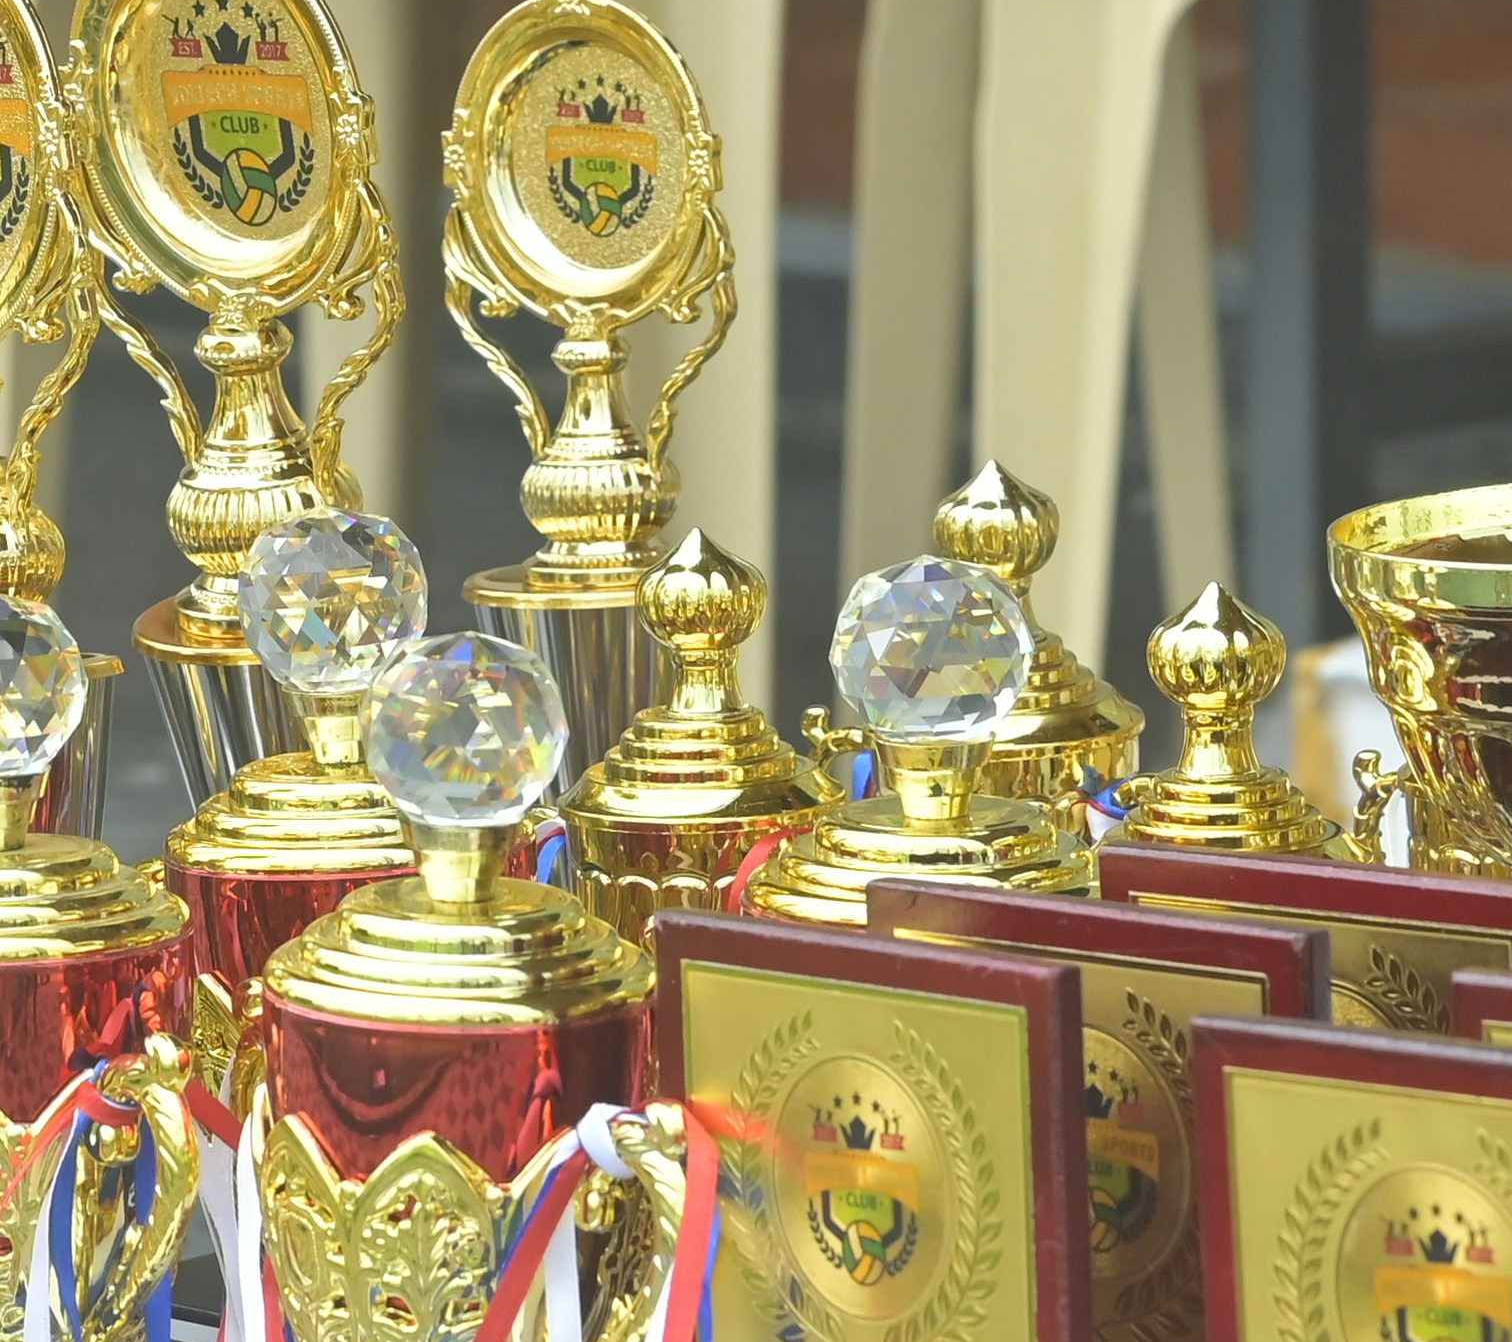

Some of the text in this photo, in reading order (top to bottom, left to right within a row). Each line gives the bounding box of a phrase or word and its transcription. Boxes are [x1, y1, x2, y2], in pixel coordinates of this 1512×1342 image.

[178, 42, 196, 55] EST.
[260, 45, 282, 57] 2017
[219, 115, 260, 134] CLUB
[586, 160, 616, 173] CLUB
[846, 1193, 876, 1210] CLUB
